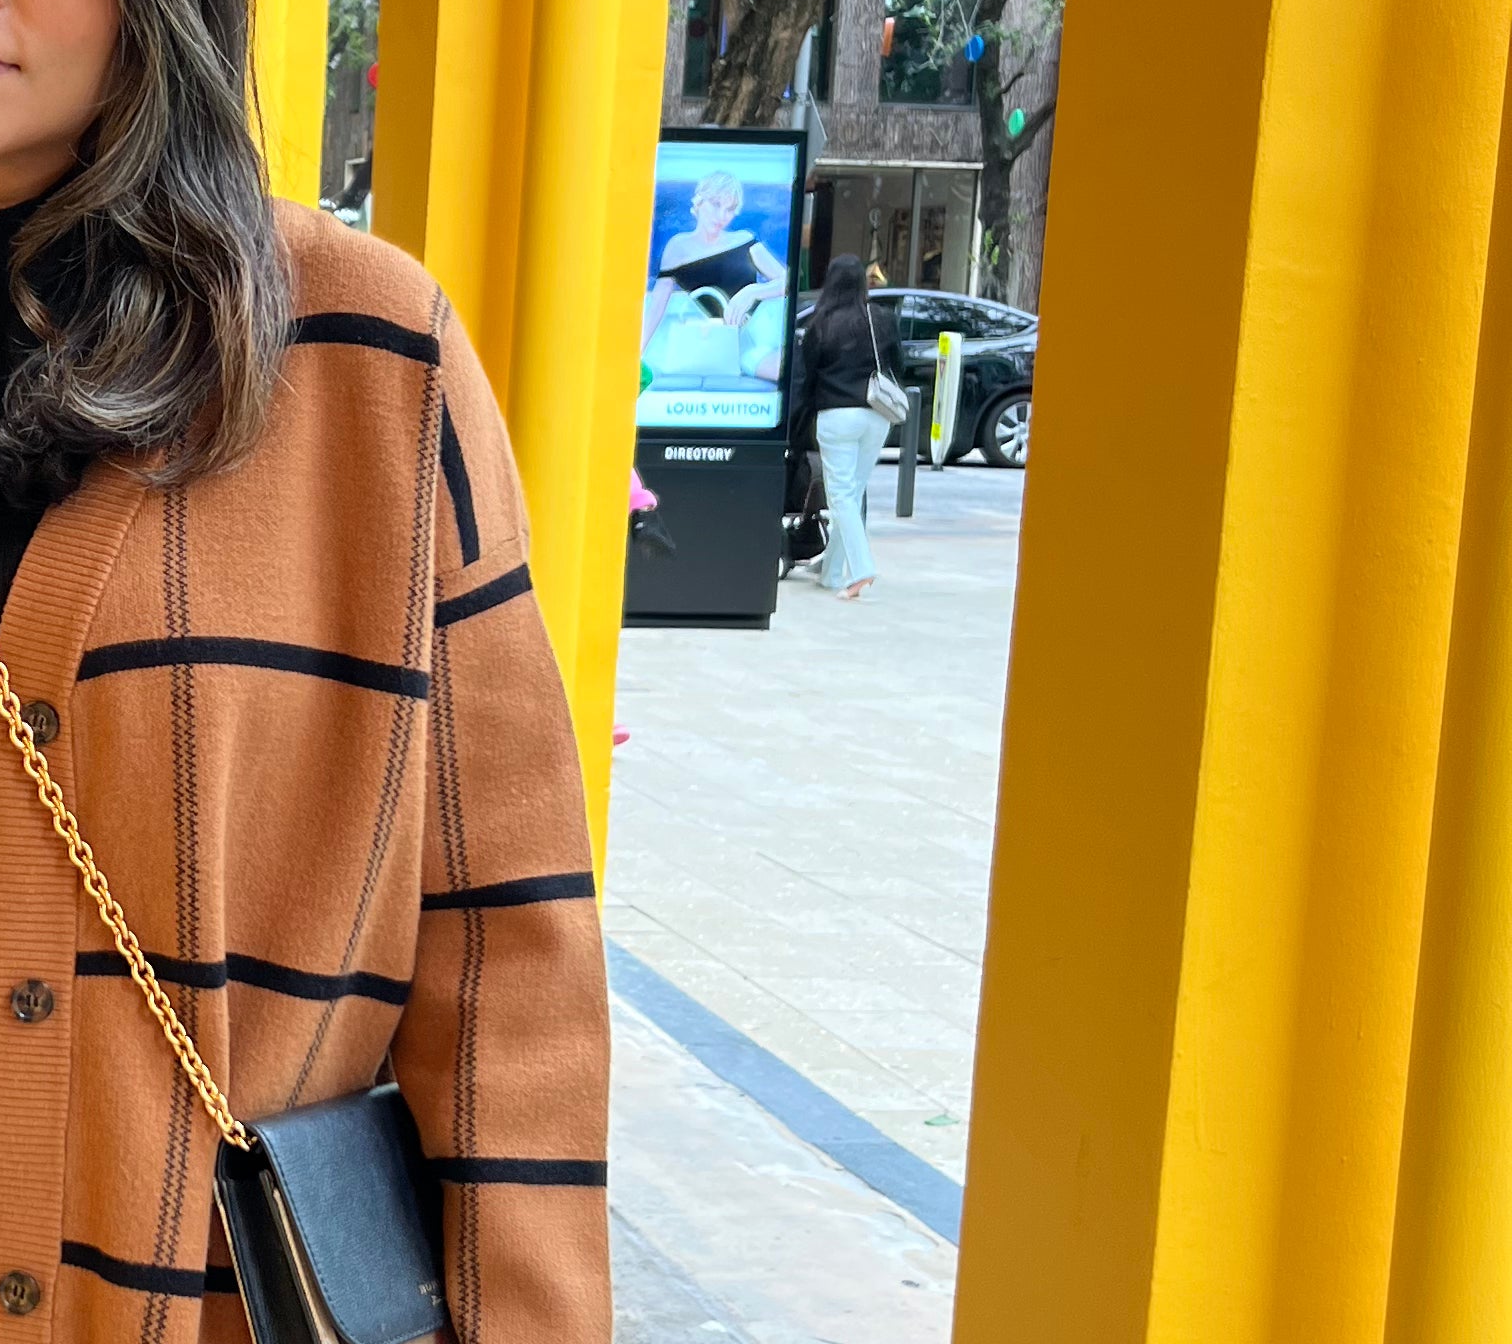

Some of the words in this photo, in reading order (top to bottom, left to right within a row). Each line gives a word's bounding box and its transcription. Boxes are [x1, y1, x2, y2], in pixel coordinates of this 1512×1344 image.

[666, 403, 707, 415] LOUIS
[712, 403, 771, 416] VUITTON
[664, 446, 733, 461] DIRECTORY
